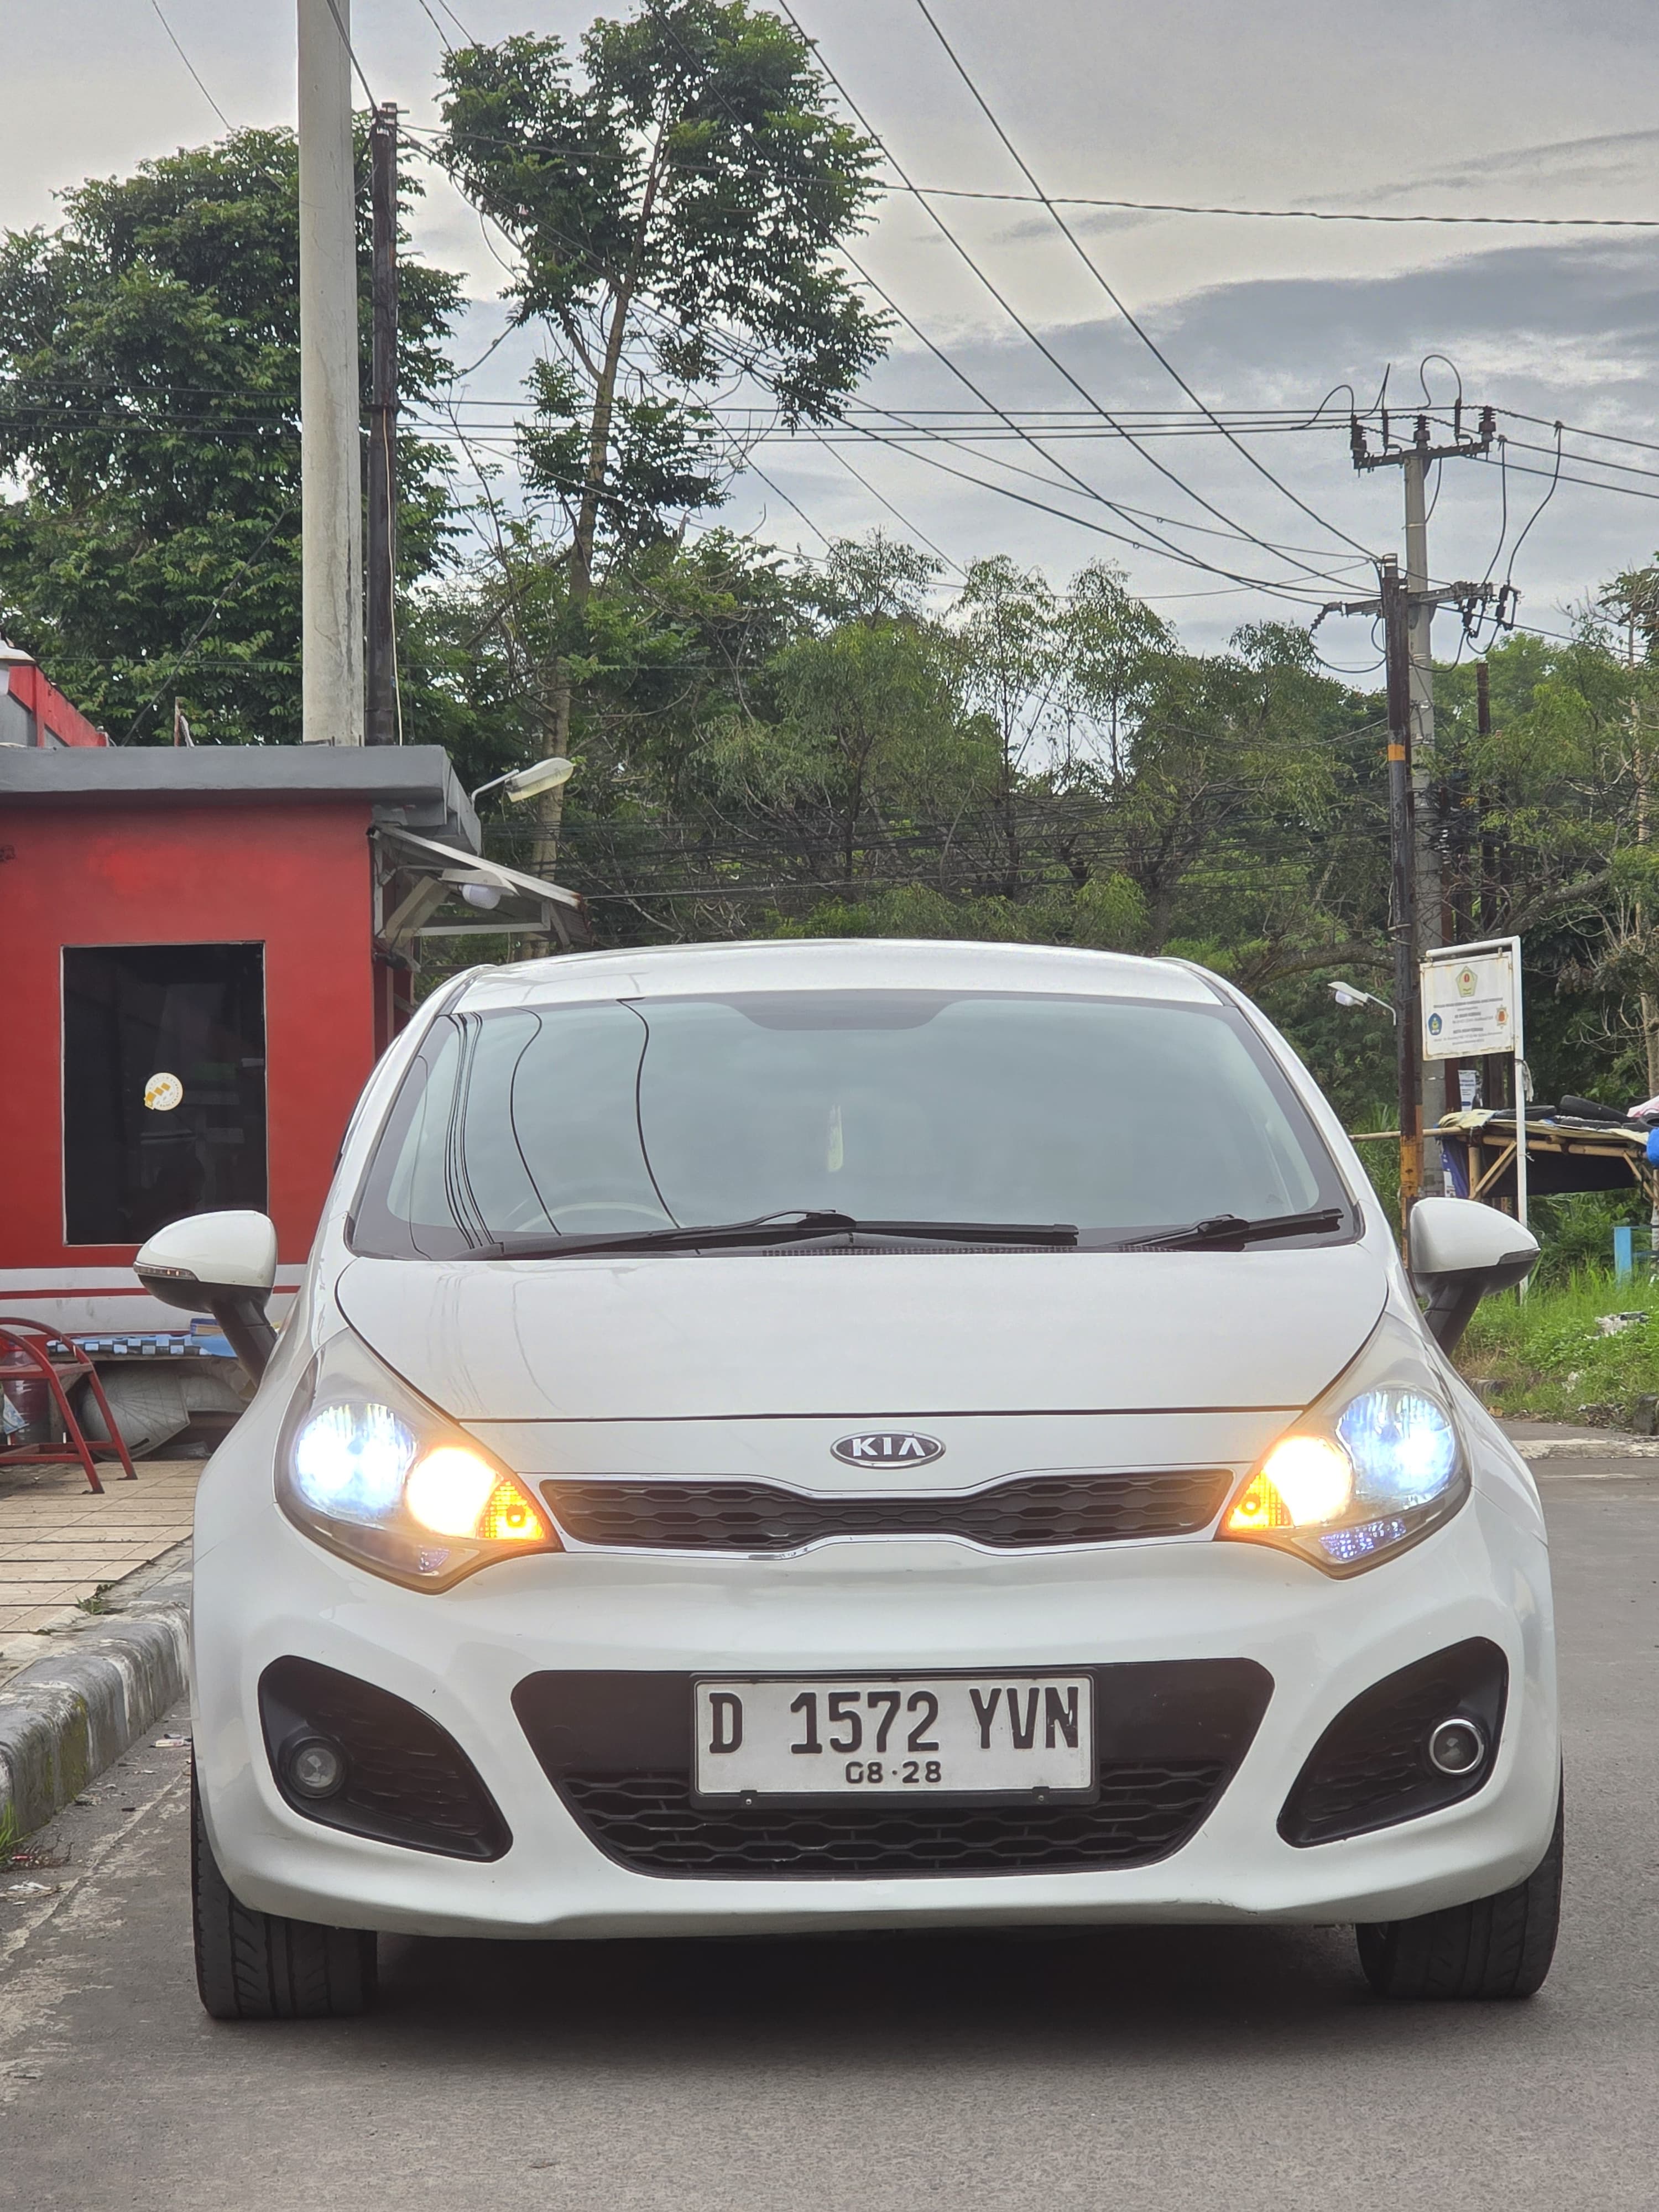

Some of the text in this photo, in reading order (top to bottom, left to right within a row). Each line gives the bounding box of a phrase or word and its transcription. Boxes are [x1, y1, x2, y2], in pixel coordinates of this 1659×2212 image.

[852, 1437, 926, 1457] KIA
[709, 1686, 1079, 1754] D 1572 YVN
